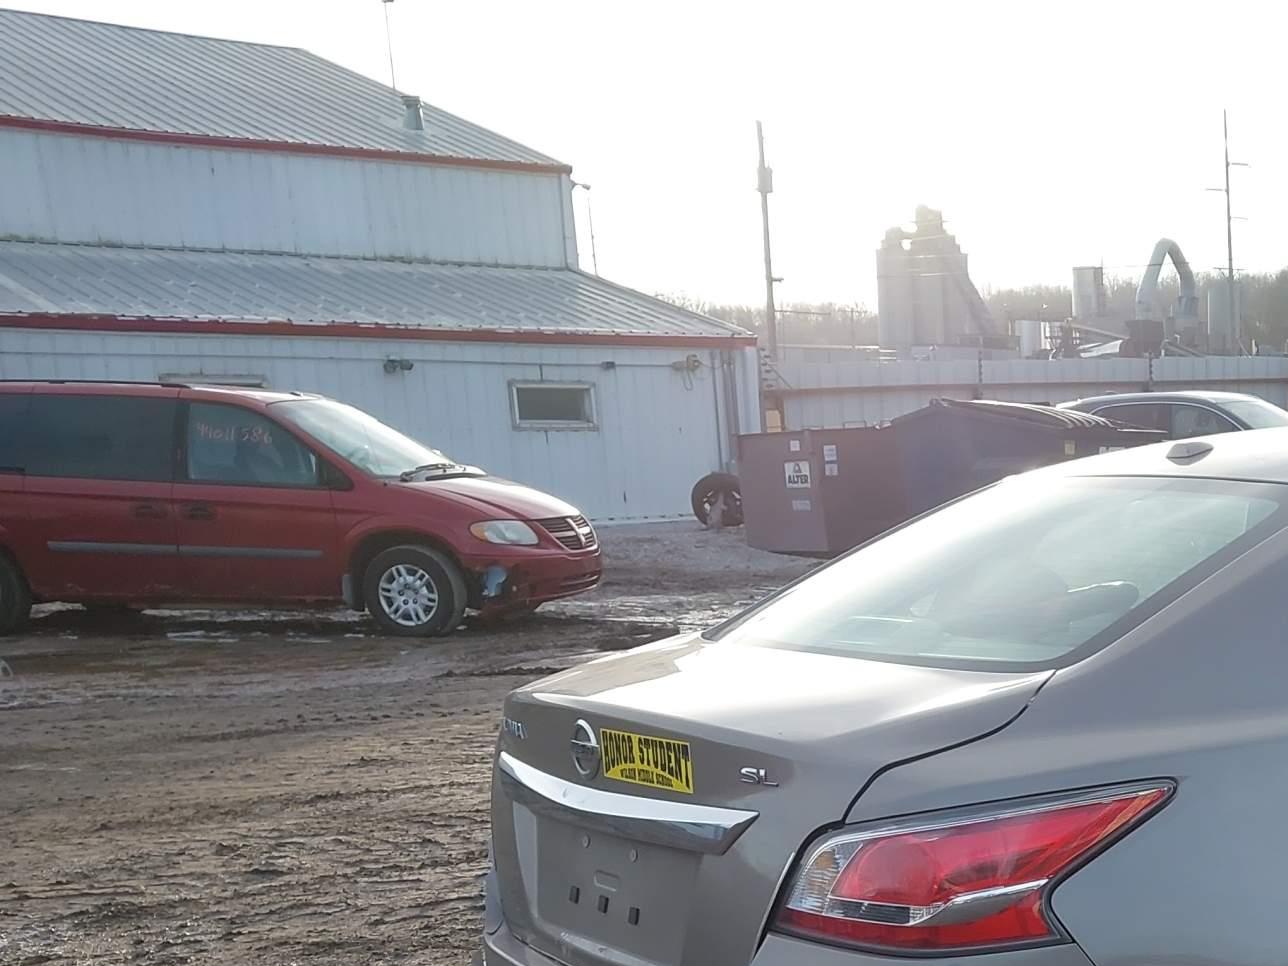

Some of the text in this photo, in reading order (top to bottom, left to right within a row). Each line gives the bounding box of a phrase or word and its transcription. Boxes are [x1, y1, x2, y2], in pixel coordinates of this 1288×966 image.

[787, 474, 809, 485] ALTER
[601, 730, 691, 790] HONOR STUDENT
[739, 767, 780, 788] SL
